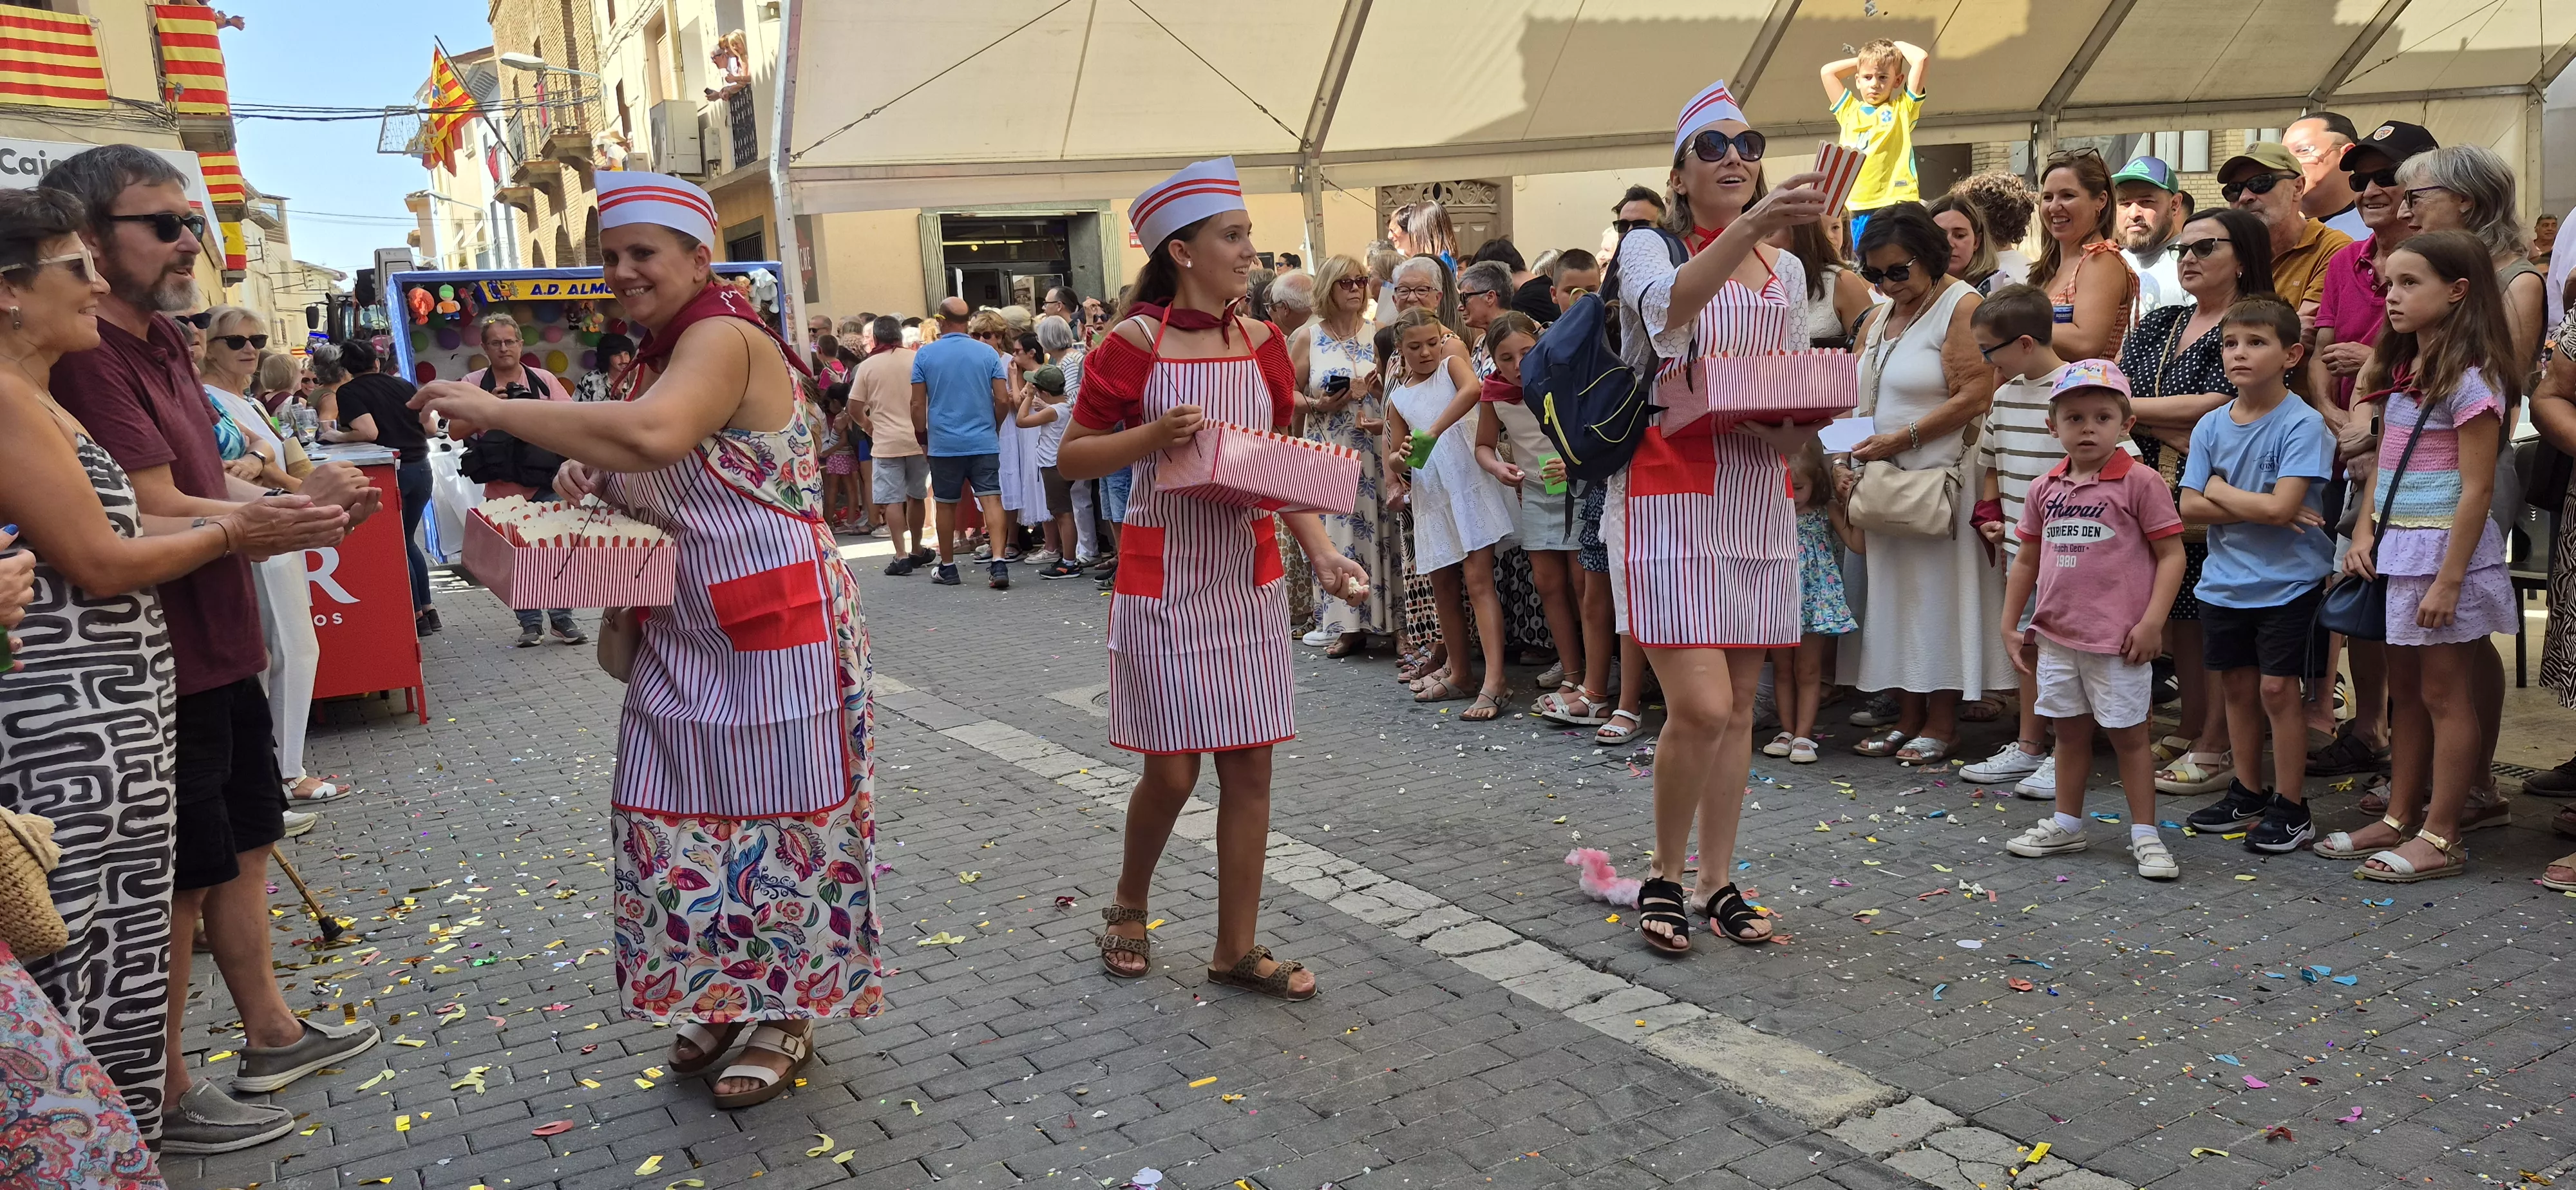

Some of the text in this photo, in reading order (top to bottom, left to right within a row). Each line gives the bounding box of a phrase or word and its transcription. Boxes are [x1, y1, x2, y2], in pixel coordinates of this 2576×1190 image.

[530, 284, 562, 296] A.D.
[2045, 493, 2108, 520] Hawaii
[2081, 526, 2101, 538] DEN
[2070, 544, 2085, 552] Gear
[2056, 554, 2077, 567] 1980
